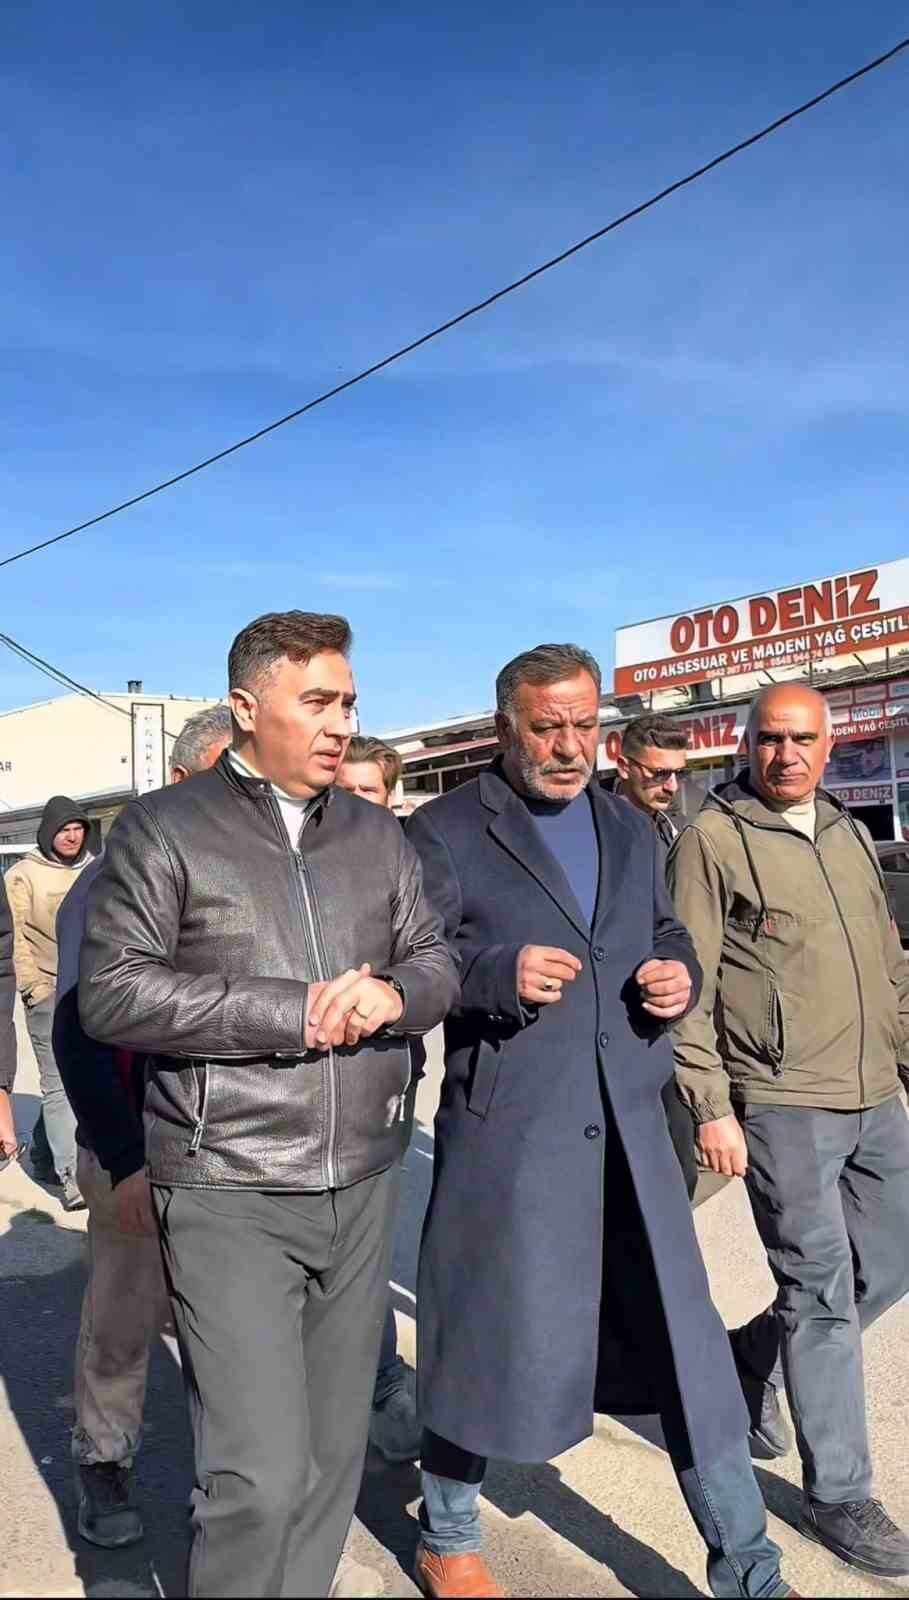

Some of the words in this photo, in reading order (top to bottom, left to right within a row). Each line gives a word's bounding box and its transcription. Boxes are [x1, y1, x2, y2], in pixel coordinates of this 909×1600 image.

[670, 605, 739, 654] OTO
[749, 569, 881, 636] DENİZ
[634, 667, 656, 683] OTO
[659, 653, 728, 679] AKSESUAR
[733, 647, 749, 664] VE
[752, 630, 811, 662] MADENİ
[815, 623, 847, 648] YAĞ
[849, 613, 909, 644] ÇEŞİTL
[680, 713, 738, 751] ENİZ
